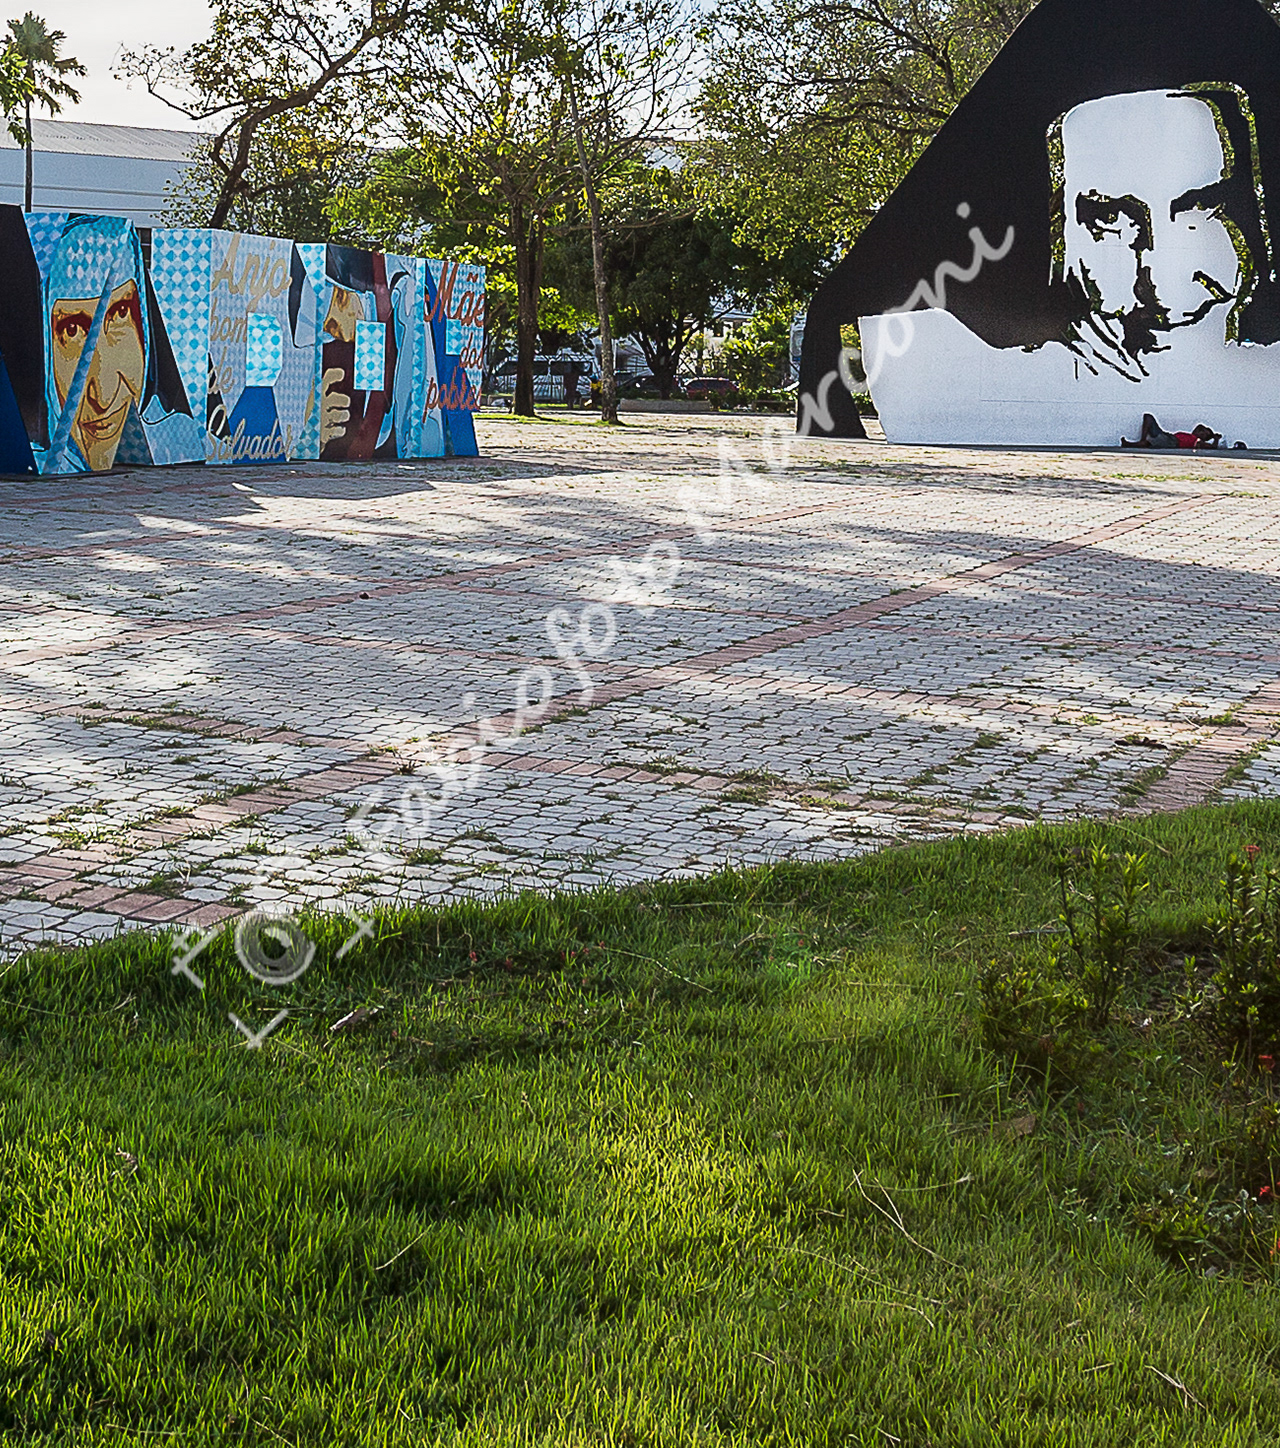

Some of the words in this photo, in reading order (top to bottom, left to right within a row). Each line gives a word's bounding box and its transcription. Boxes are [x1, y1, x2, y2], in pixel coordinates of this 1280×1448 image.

[211, 233, 293, 313] Anjo
[423, 261, 486, 328] Mãe
[210, 297, 247, 343] bom
[207, 346, 234, 395] de
[205, 404, 295, 462] Salvador
